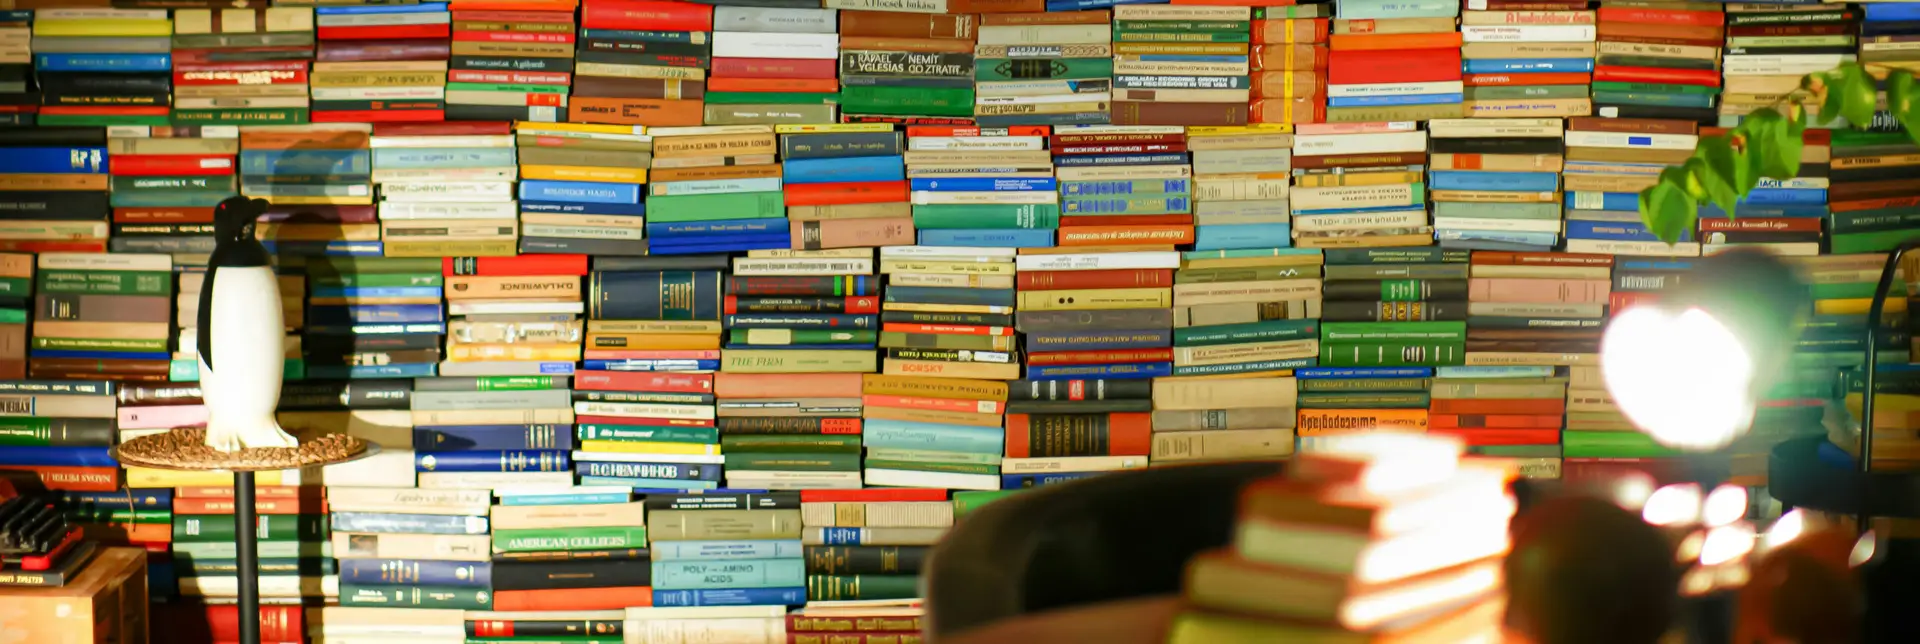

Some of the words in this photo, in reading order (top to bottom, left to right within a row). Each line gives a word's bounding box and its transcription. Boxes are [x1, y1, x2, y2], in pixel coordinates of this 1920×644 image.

[908, 54, 939, 65] NEMÍT
[859, 62, 904, 73] YGLESIAS
[731, 357, 753, 366] THE
[755, 357, 784, 367] FIRM
[509, 536, 568, 549] AMERICAN
[570, 535, 626, 547] COLLEGES
[704, 575, 733, 583] ACIDS
